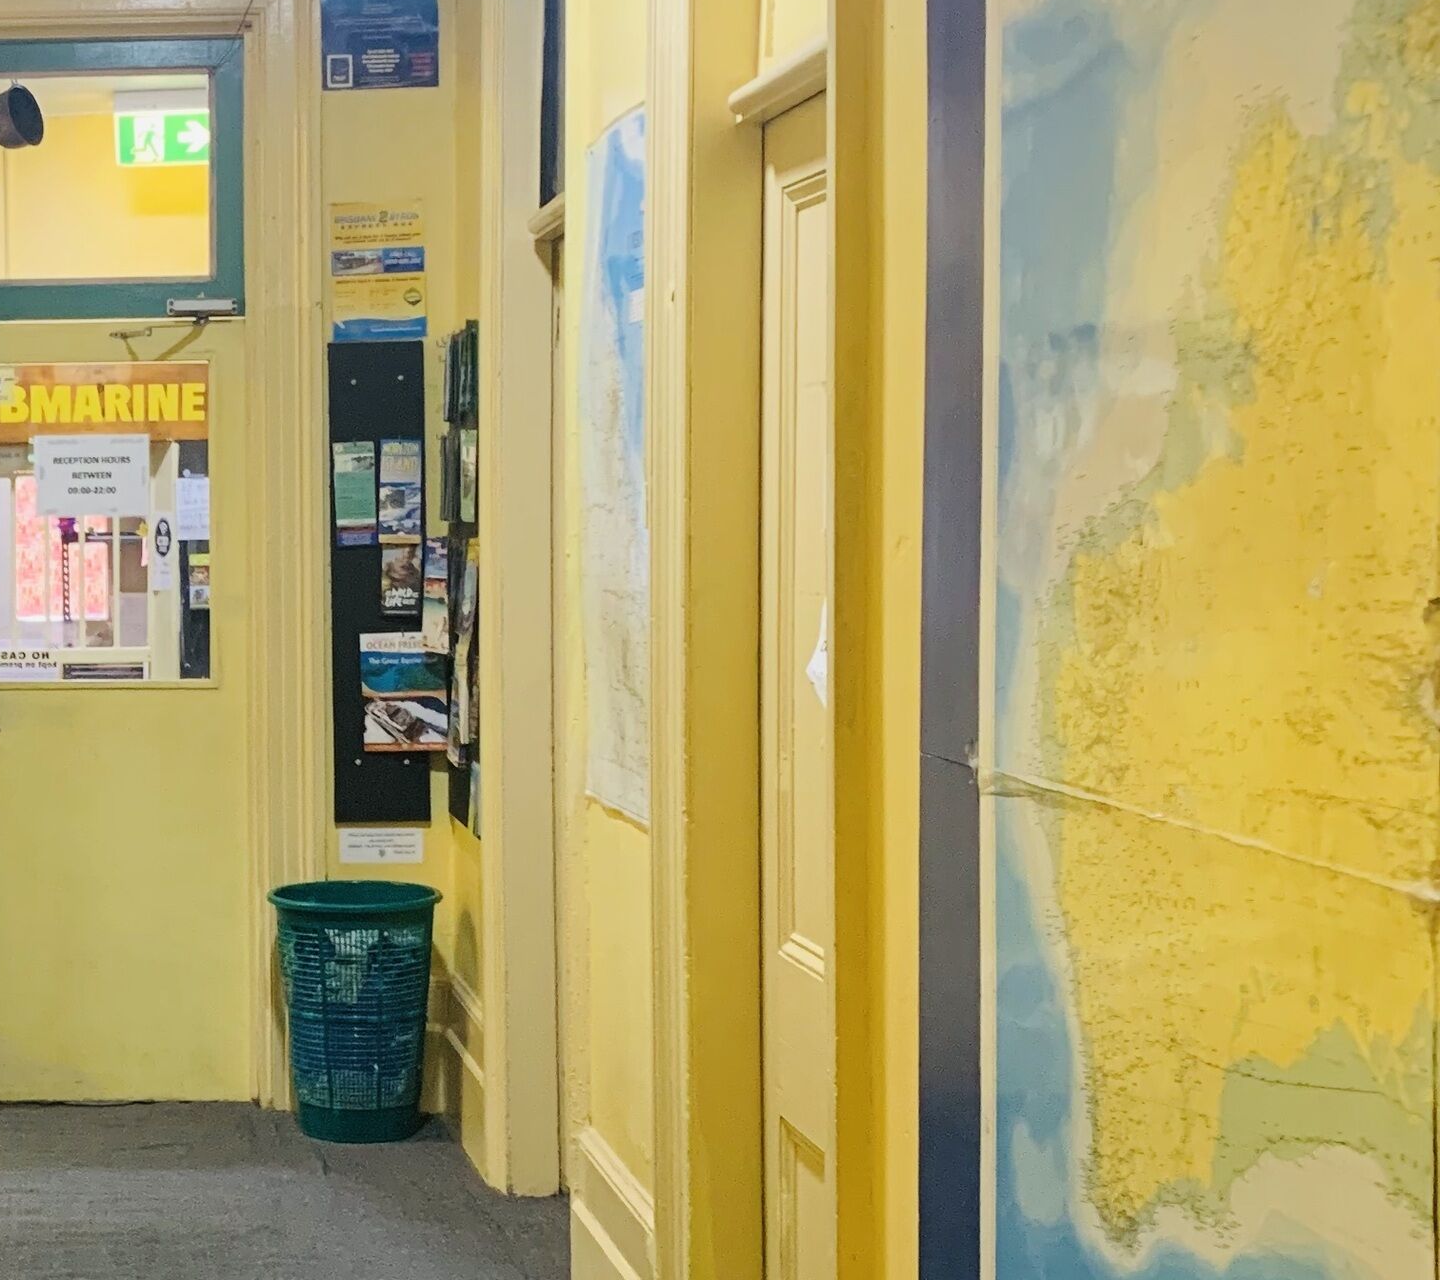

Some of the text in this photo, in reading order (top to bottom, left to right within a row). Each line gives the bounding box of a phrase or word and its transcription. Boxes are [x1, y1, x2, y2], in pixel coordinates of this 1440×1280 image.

[52, 456, 131, 465] RECEPTION HOURS
[72, 471, 112, 479] BETWEEN
